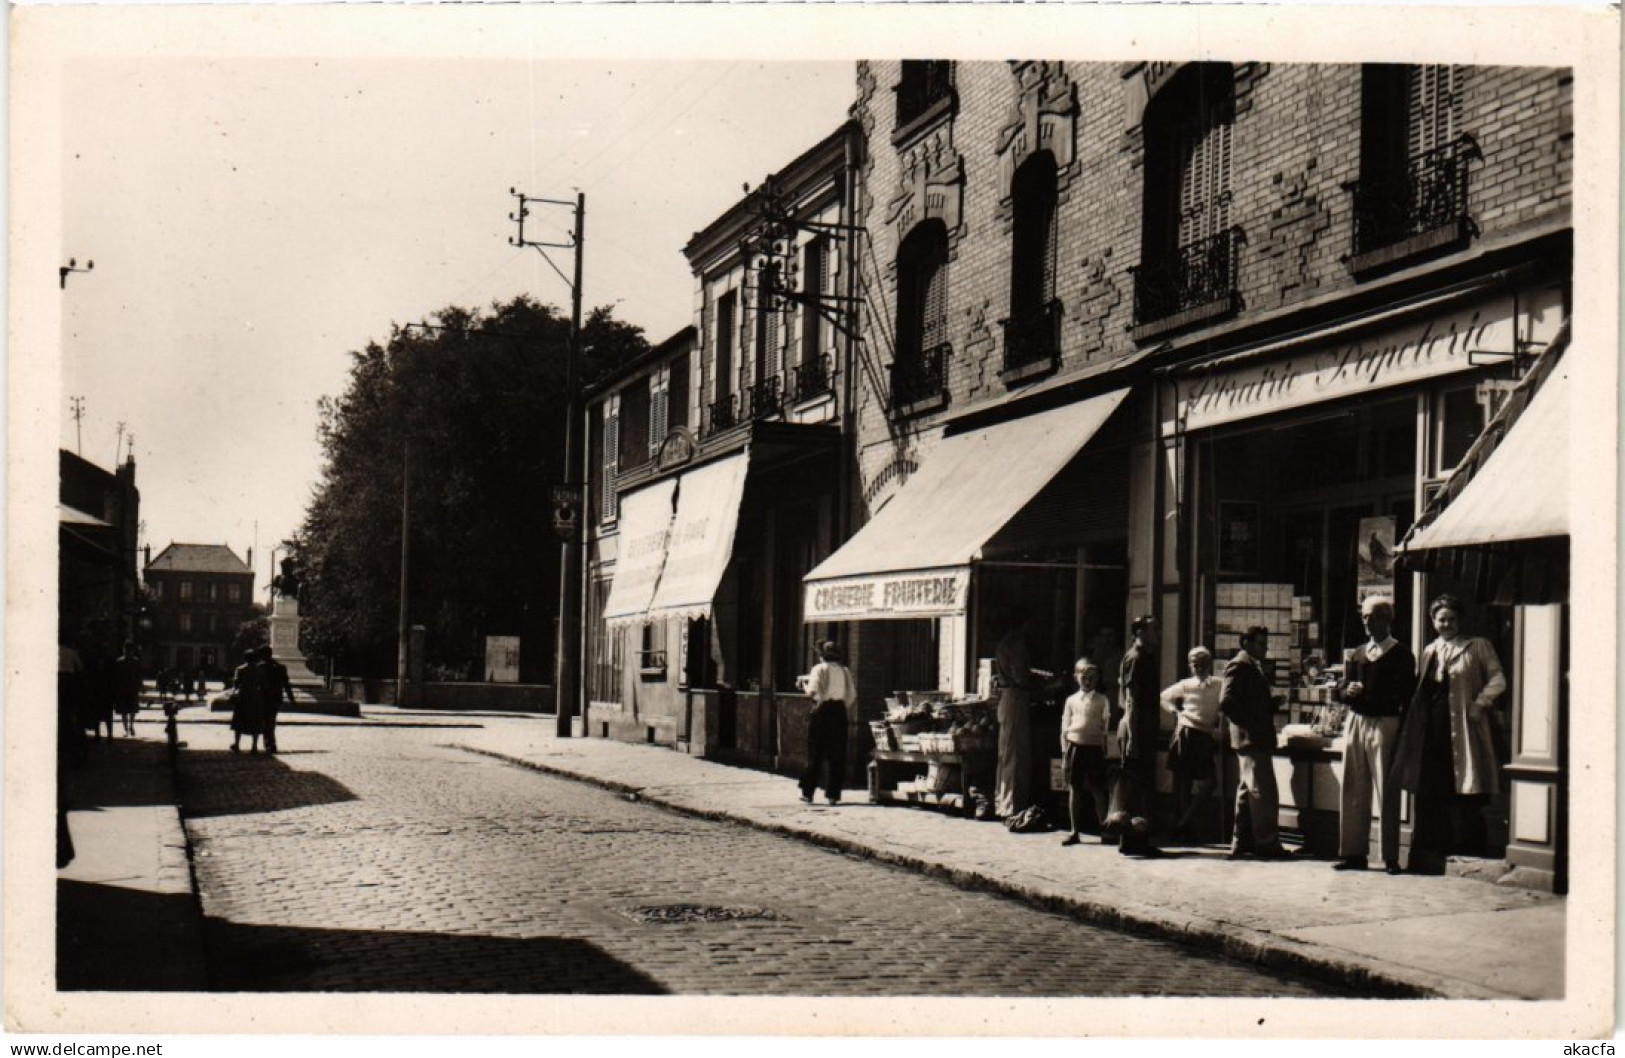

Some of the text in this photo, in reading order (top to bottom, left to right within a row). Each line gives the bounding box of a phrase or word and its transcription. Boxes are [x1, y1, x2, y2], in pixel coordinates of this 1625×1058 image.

[1187, 311, 1496, 413] Librairie Papeterie
[884, 577, 956, 608] FRUITERIE
